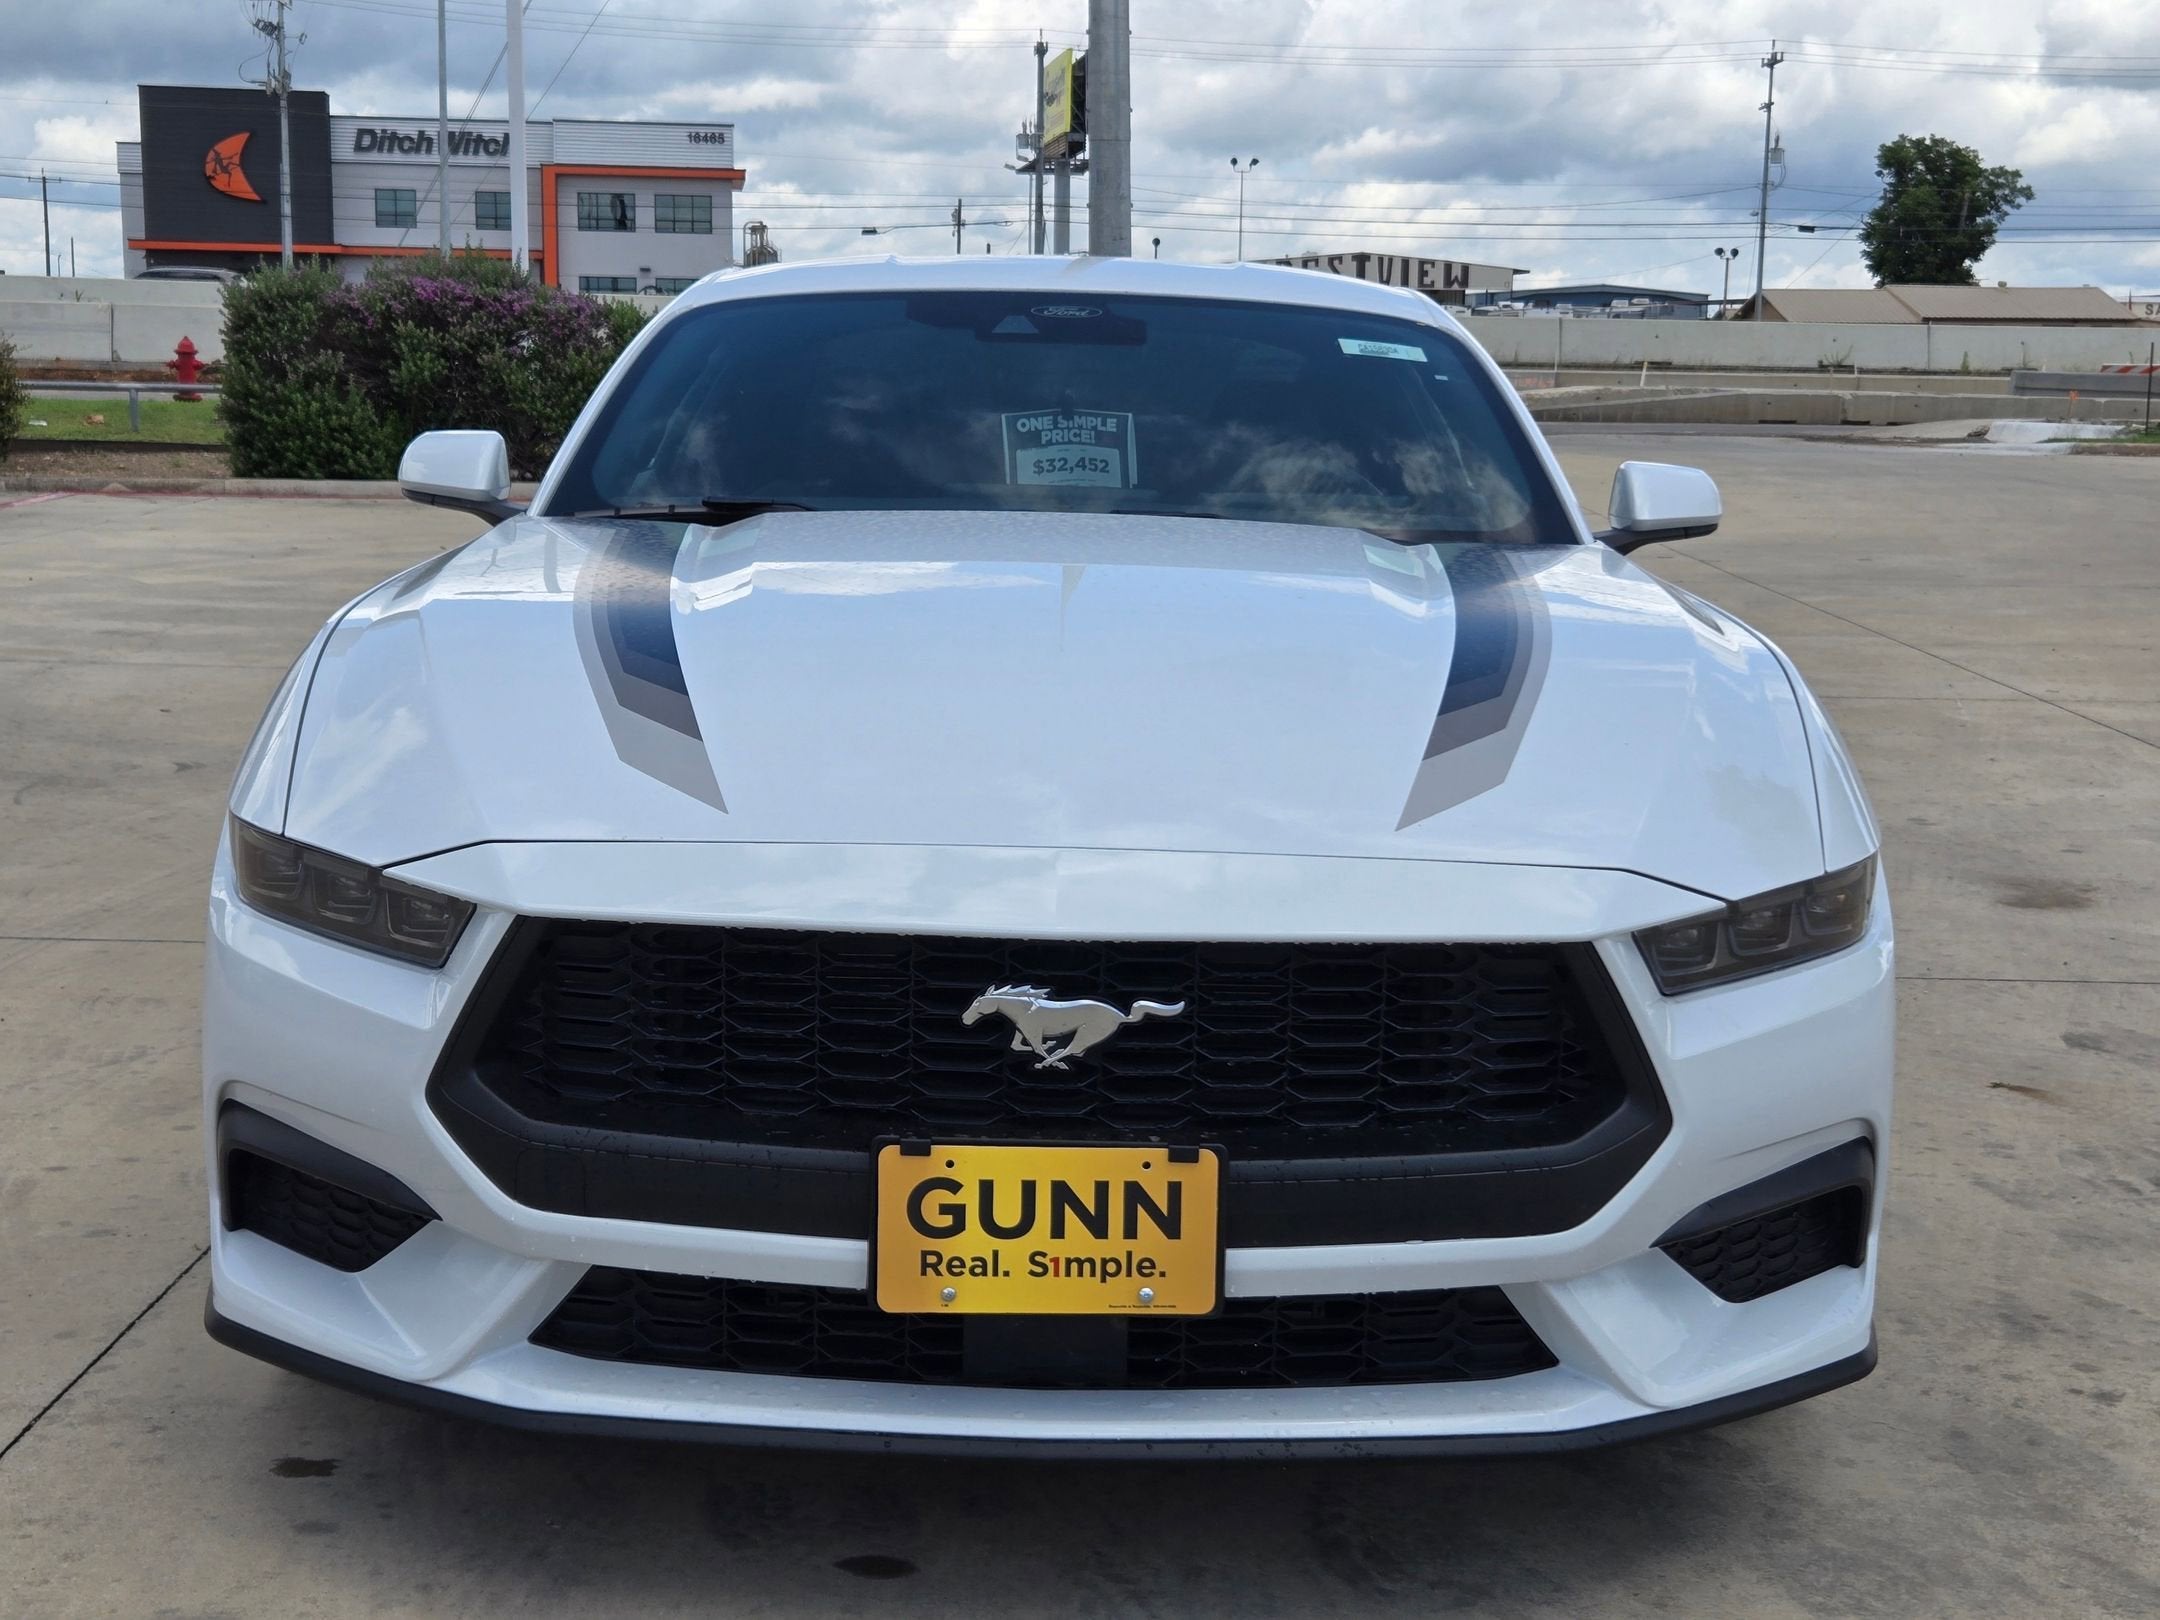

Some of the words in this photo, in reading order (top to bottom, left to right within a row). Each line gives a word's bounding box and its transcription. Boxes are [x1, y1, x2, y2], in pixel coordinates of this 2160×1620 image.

[353, 128, 433, 154] Ditch
[687, 131, 725, 145] 16465
[1016, 416, 1053, 432] ONE
[1041, 429, 1095, 444] PRICE!
[1032, 457, 1110, 475] $32,452
[906, 1176, 1182, 1240] GUNN
[919, 1249, 1011, 1278] Real.
[1027, 1250, 1167, 1284] S1mple.
